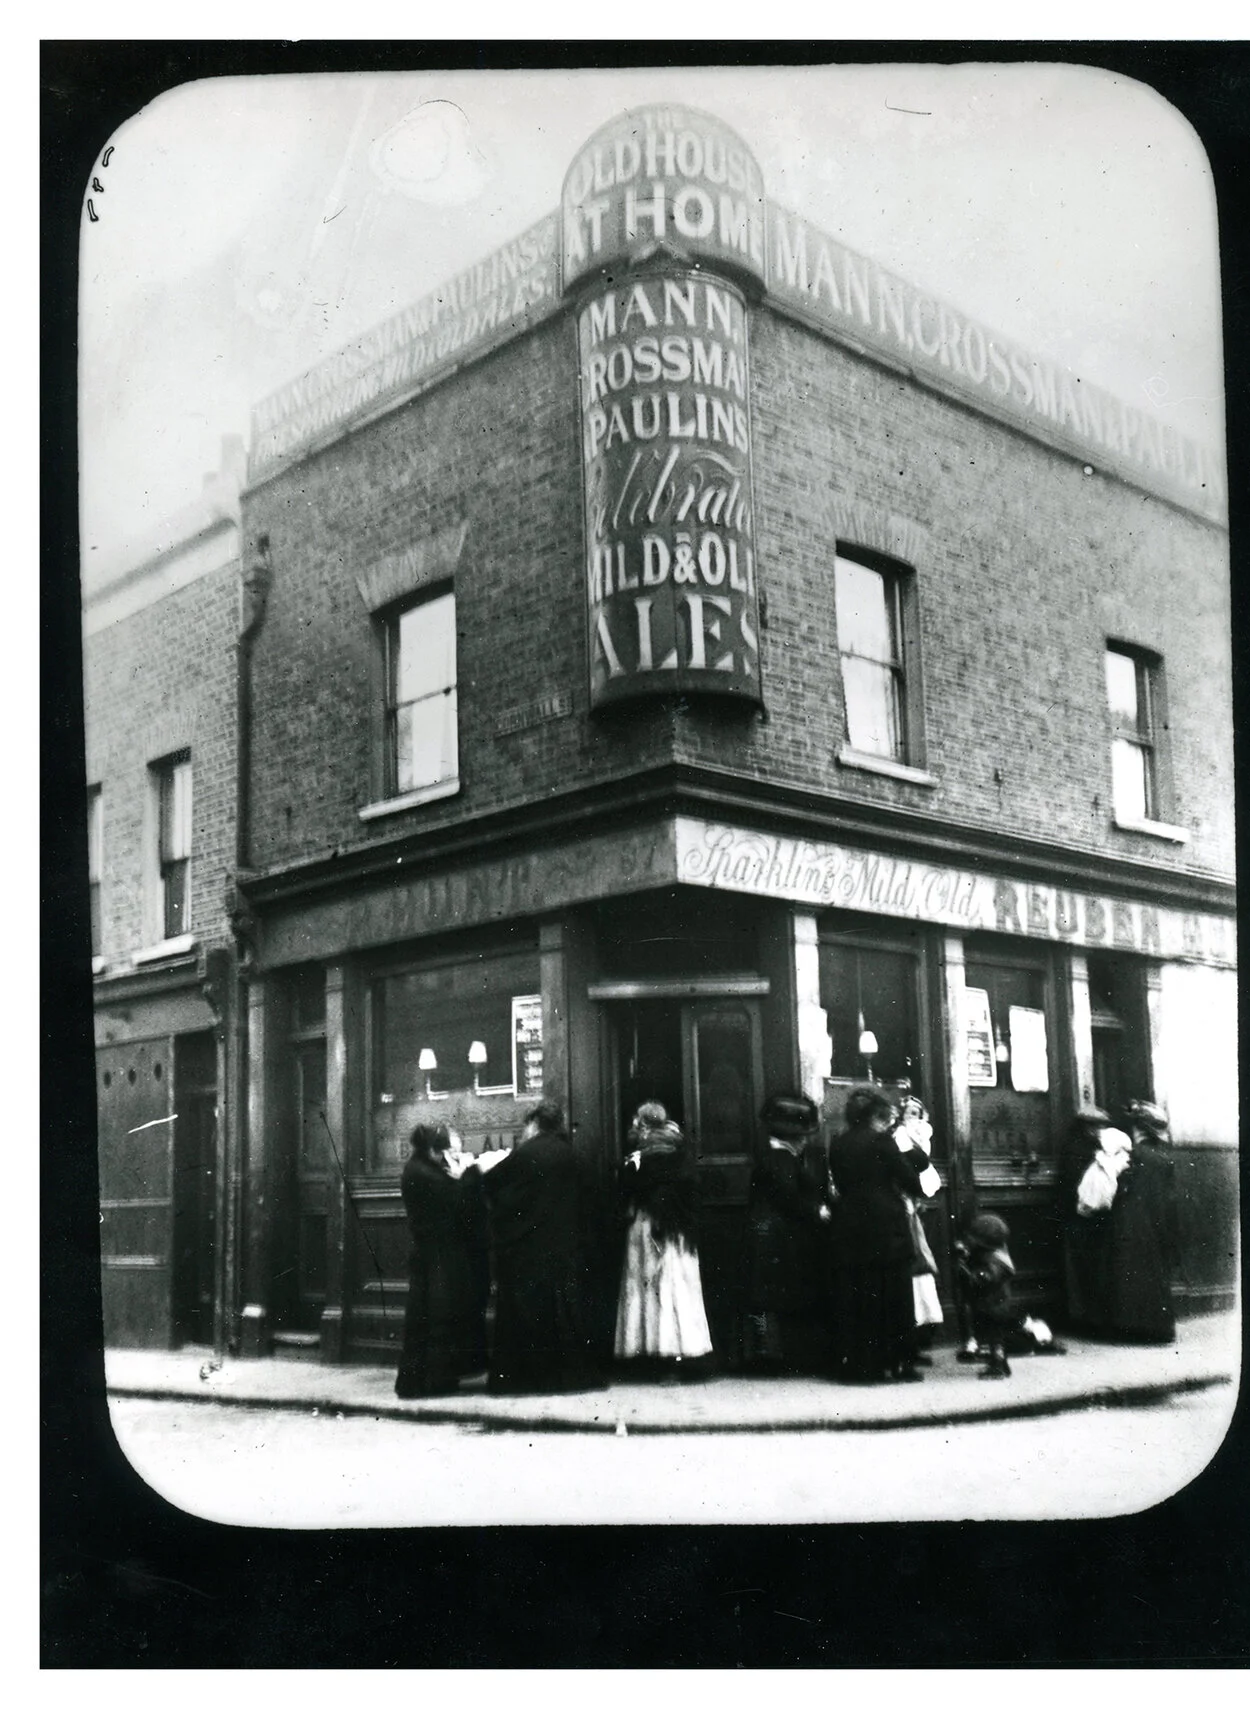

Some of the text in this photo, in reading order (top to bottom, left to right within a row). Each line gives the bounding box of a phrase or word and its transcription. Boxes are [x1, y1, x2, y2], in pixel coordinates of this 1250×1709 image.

[565, 138, 641, 206] OLD
[588, 391, 748, 458] PAULINS
[674, 541, 698, 584] &
